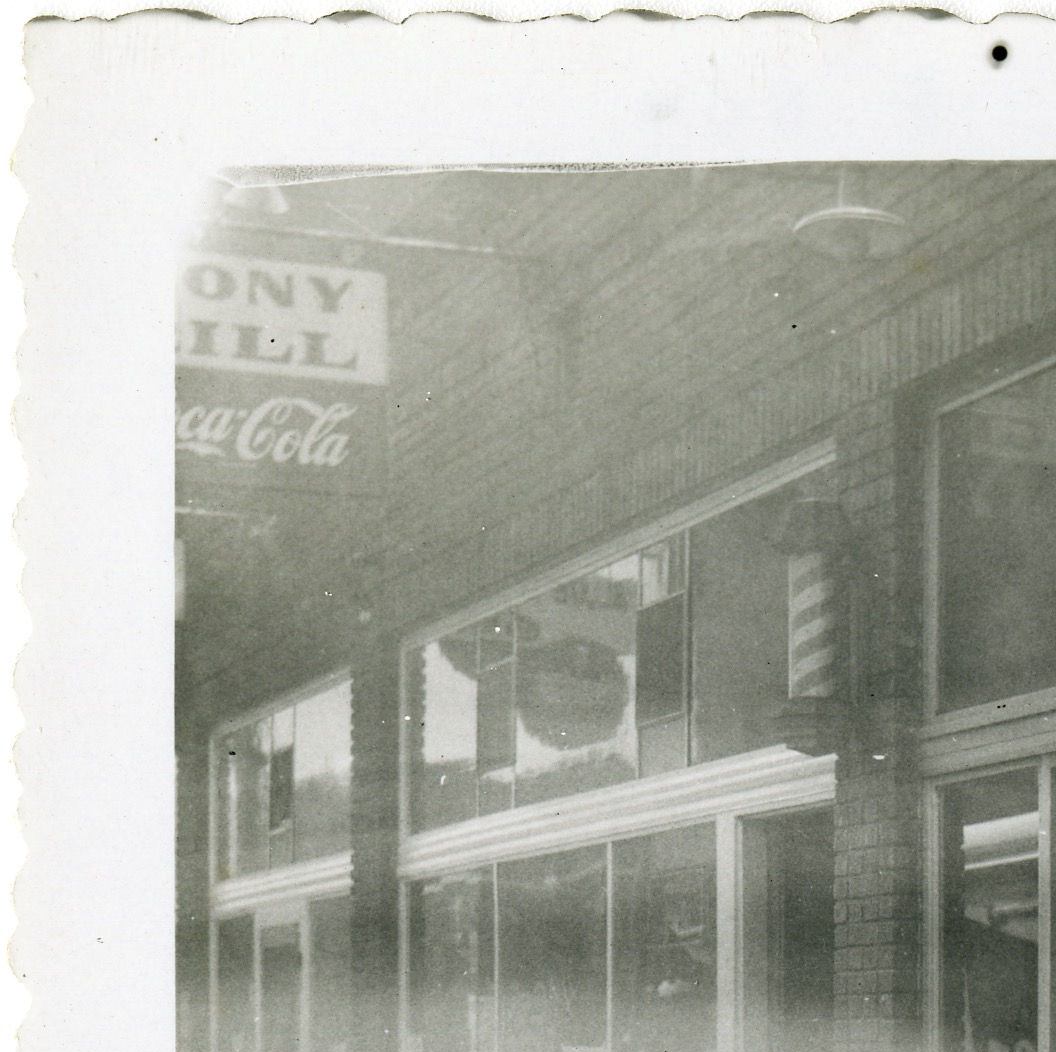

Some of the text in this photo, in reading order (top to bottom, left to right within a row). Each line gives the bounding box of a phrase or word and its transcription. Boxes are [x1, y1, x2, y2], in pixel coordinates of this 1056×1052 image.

[184, 264, 353, 314] ONY
[176, 319, 359, 371] ILL
[176, 398, 358, 467] ca-Cola
